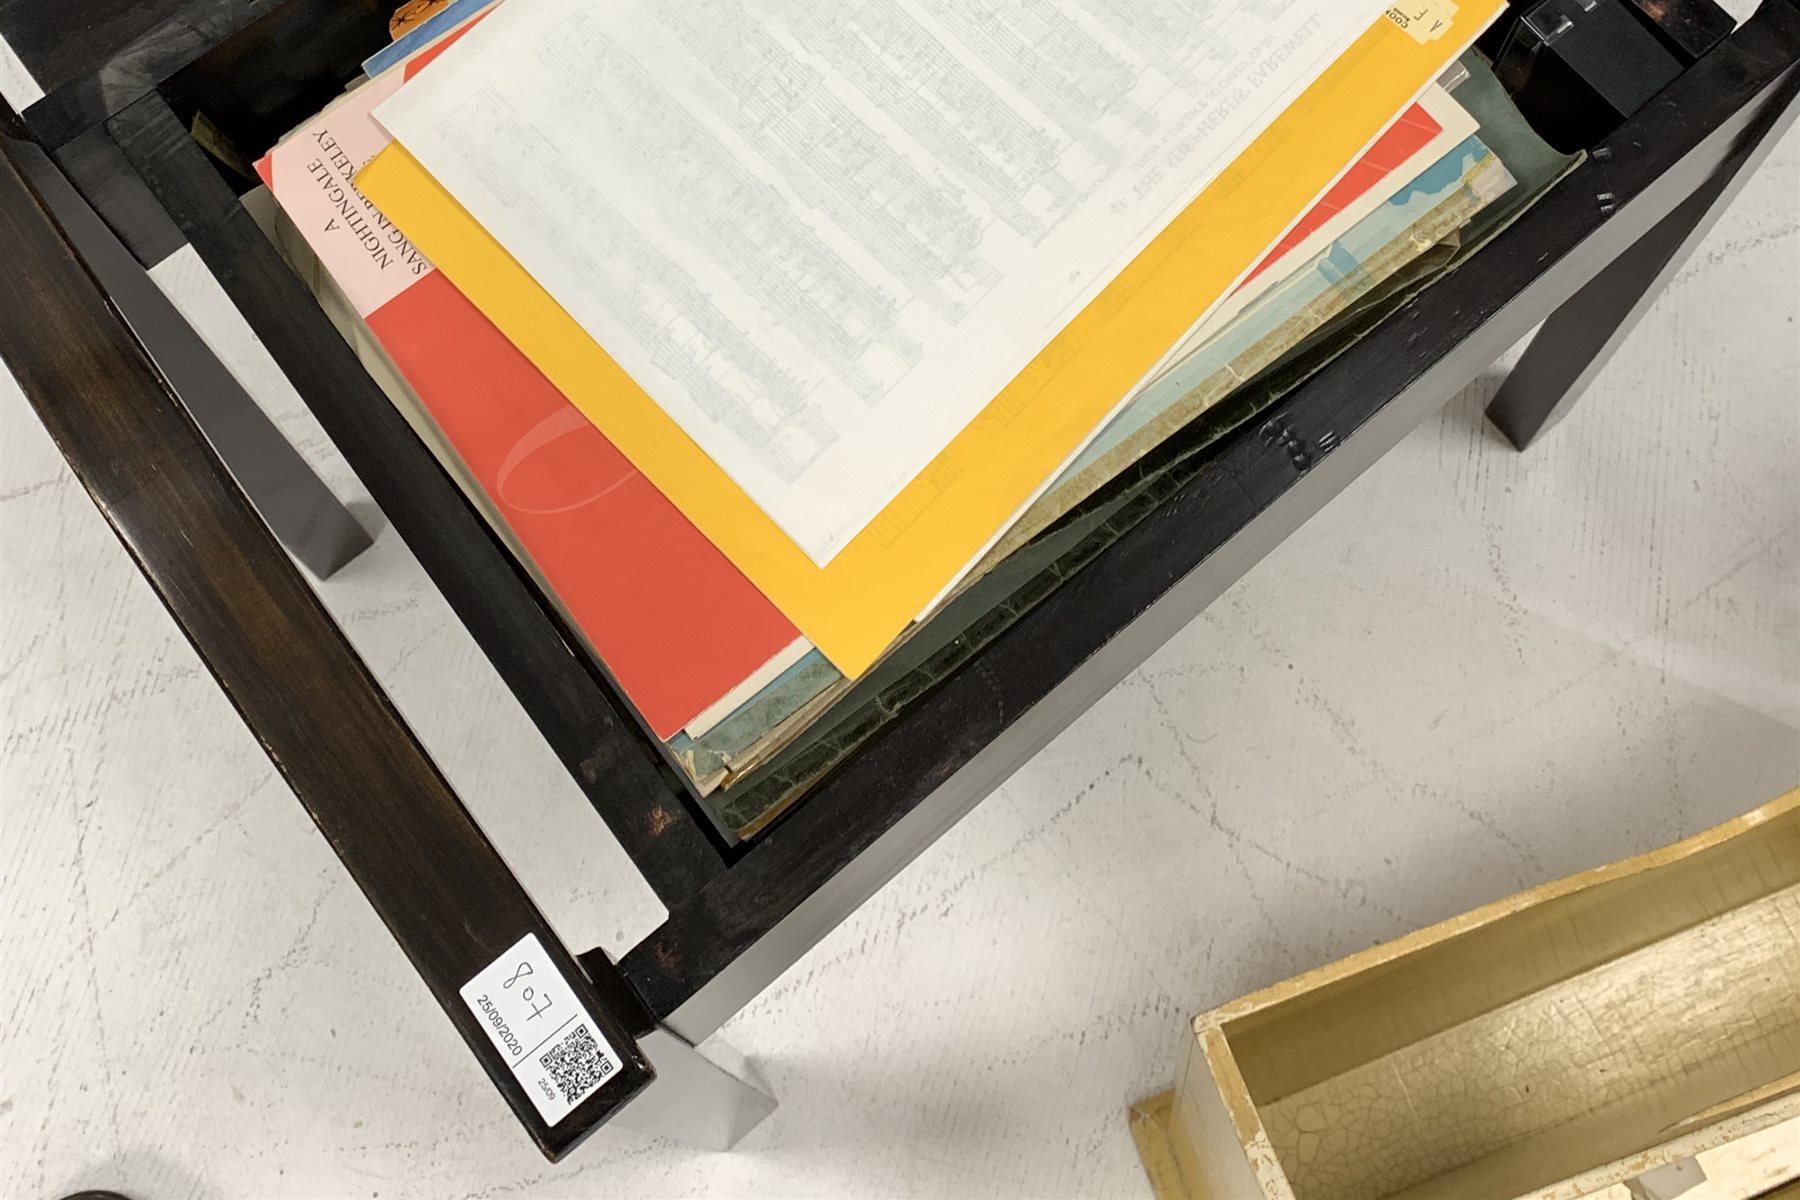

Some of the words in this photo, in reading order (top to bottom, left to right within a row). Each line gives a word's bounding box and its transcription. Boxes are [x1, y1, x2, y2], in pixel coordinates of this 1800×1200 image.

[307, 158, 395, 271] NIGHTINGALE
[324, 218, 340, 233] A
[372, 210, 393, 230] IN
[387, 229, 427, 275] SANG
[503, 961, 553, 1021] 807
[477, 994, 523, 1056] 25/09/2020
[538, 1078, 556, 1101] 25/09
